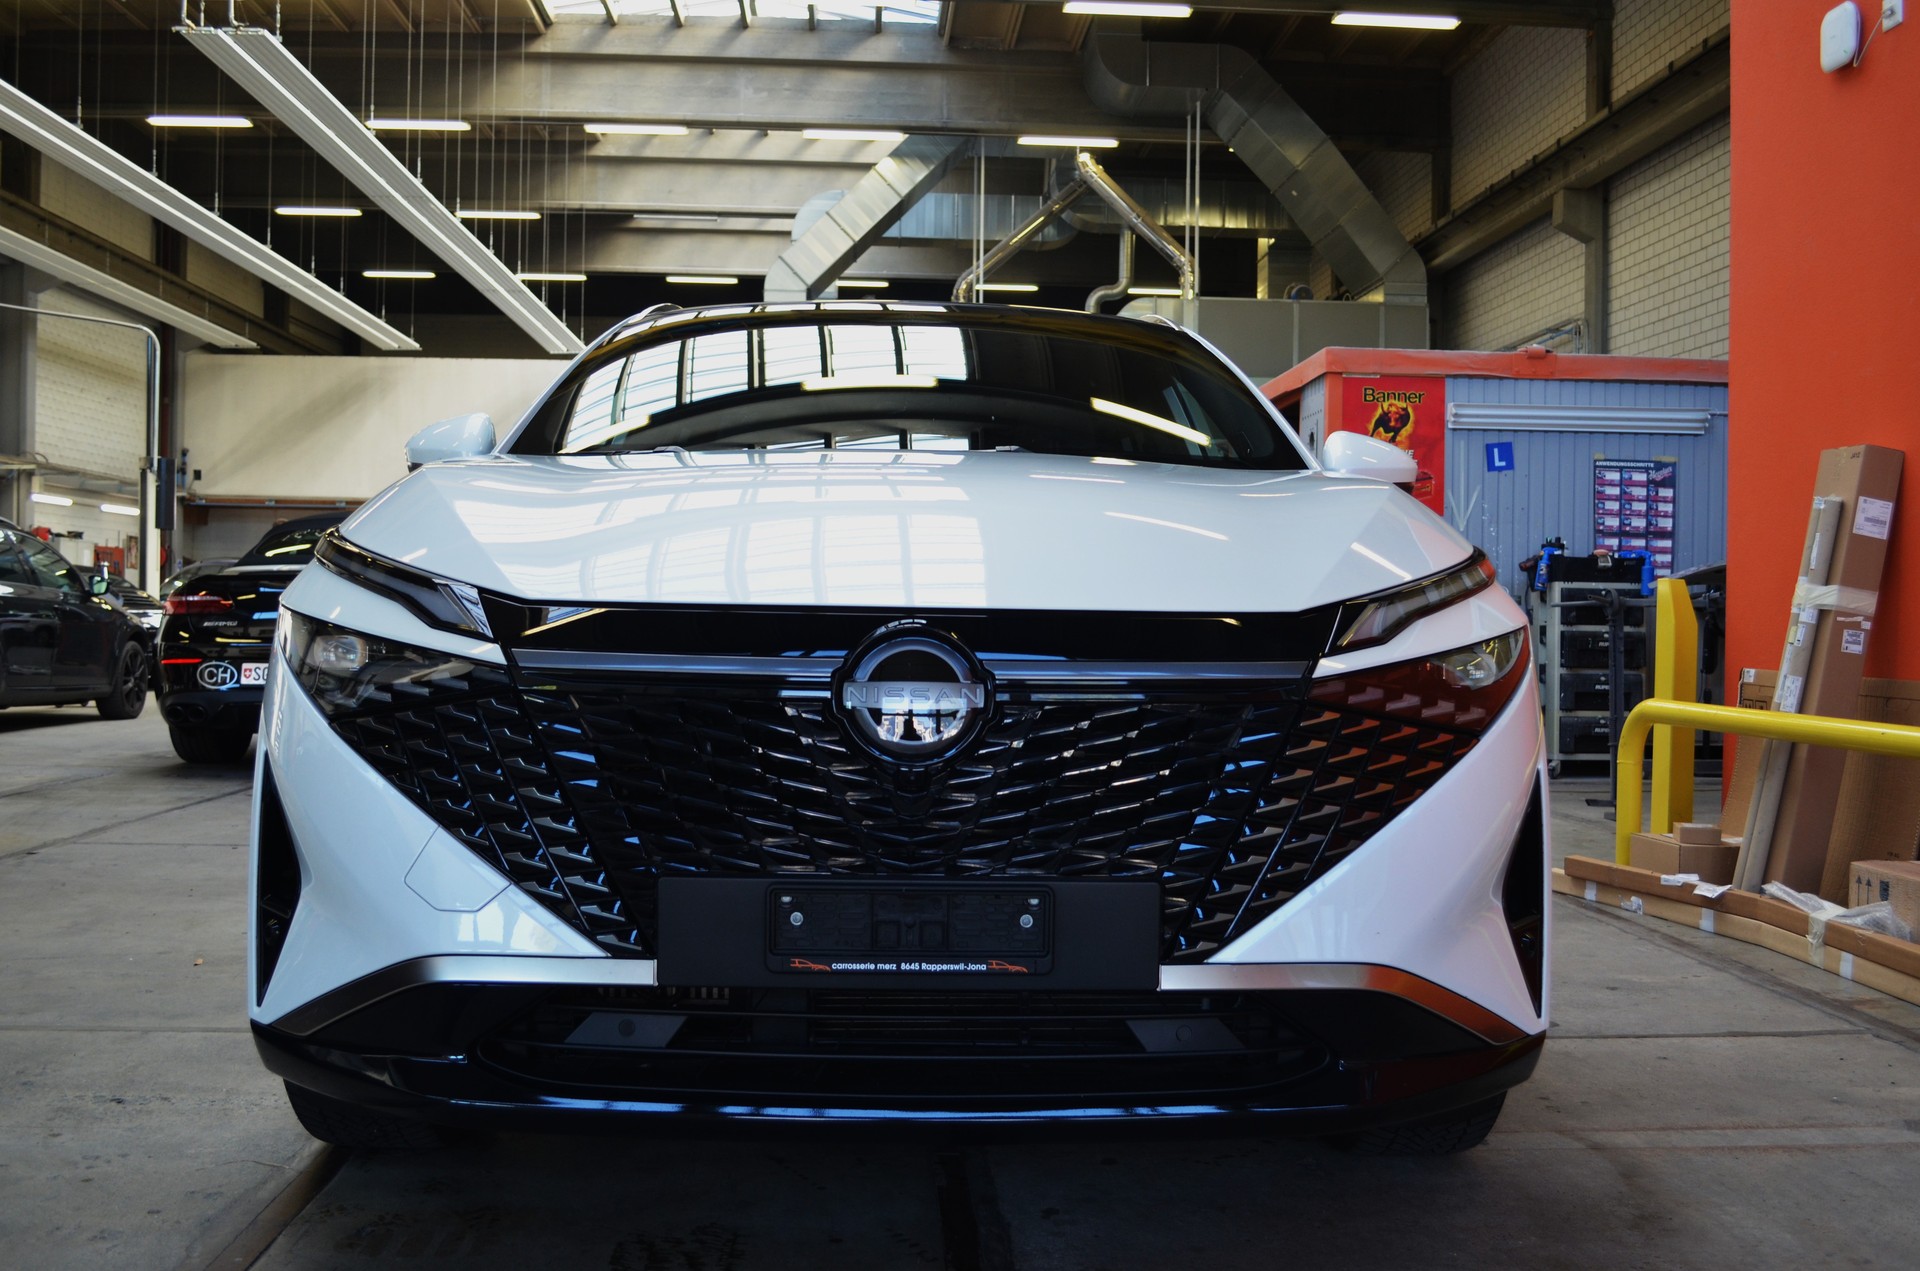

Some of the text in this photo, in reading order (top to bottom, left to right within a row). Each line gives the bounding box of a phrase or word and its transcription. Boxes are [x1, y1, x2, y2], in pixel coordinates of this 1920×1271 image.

[1363, 387, 1425, 403] Banner
[1493, 447, 1506, 467] L
[204, 667, 231, 684] CH
[847, 686, 981, 705] NISSAN
[831, 962, 875, 970] carrosserie
[900, 962, 920, 970] 8645
[921, 962, 987, 972] Rapperswil-Jona
